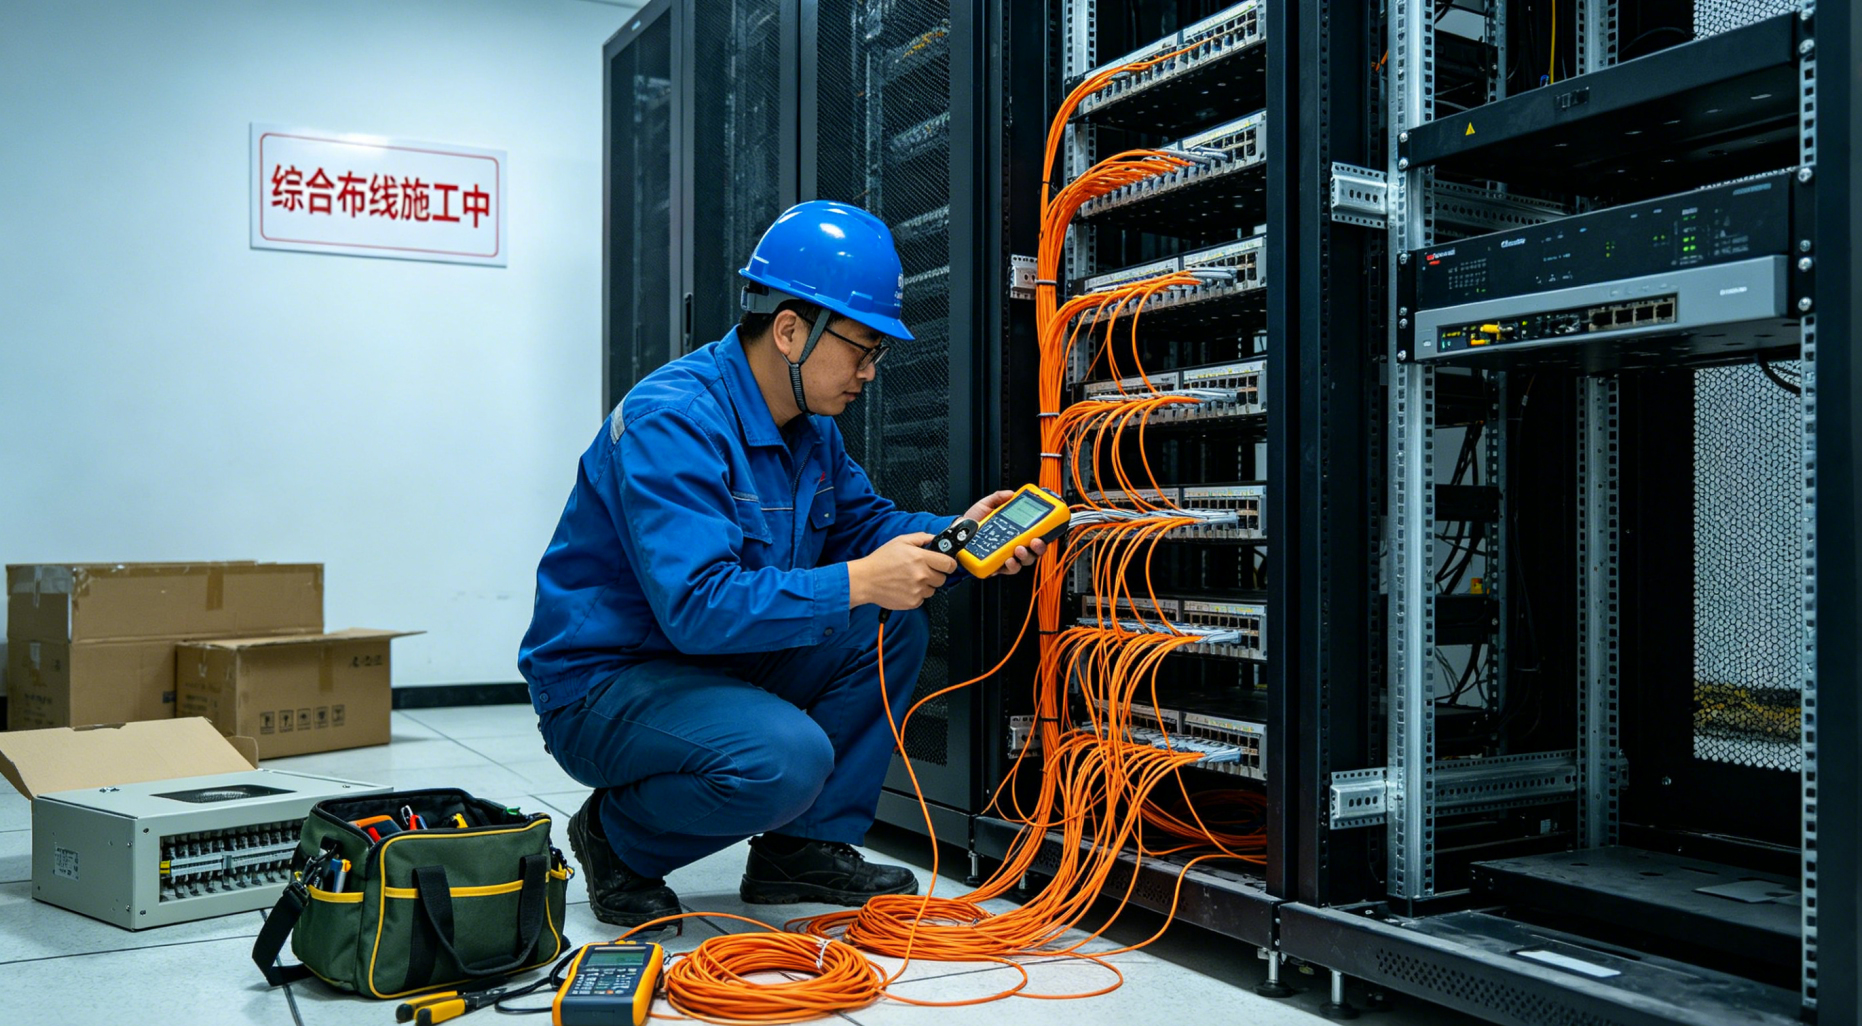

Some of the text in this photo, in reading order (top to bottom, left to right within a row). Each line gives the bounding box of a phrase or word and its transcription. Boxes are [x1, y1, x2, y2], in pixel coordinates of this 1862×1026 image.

[271, 164, 490, 228] 综合布线施工中
